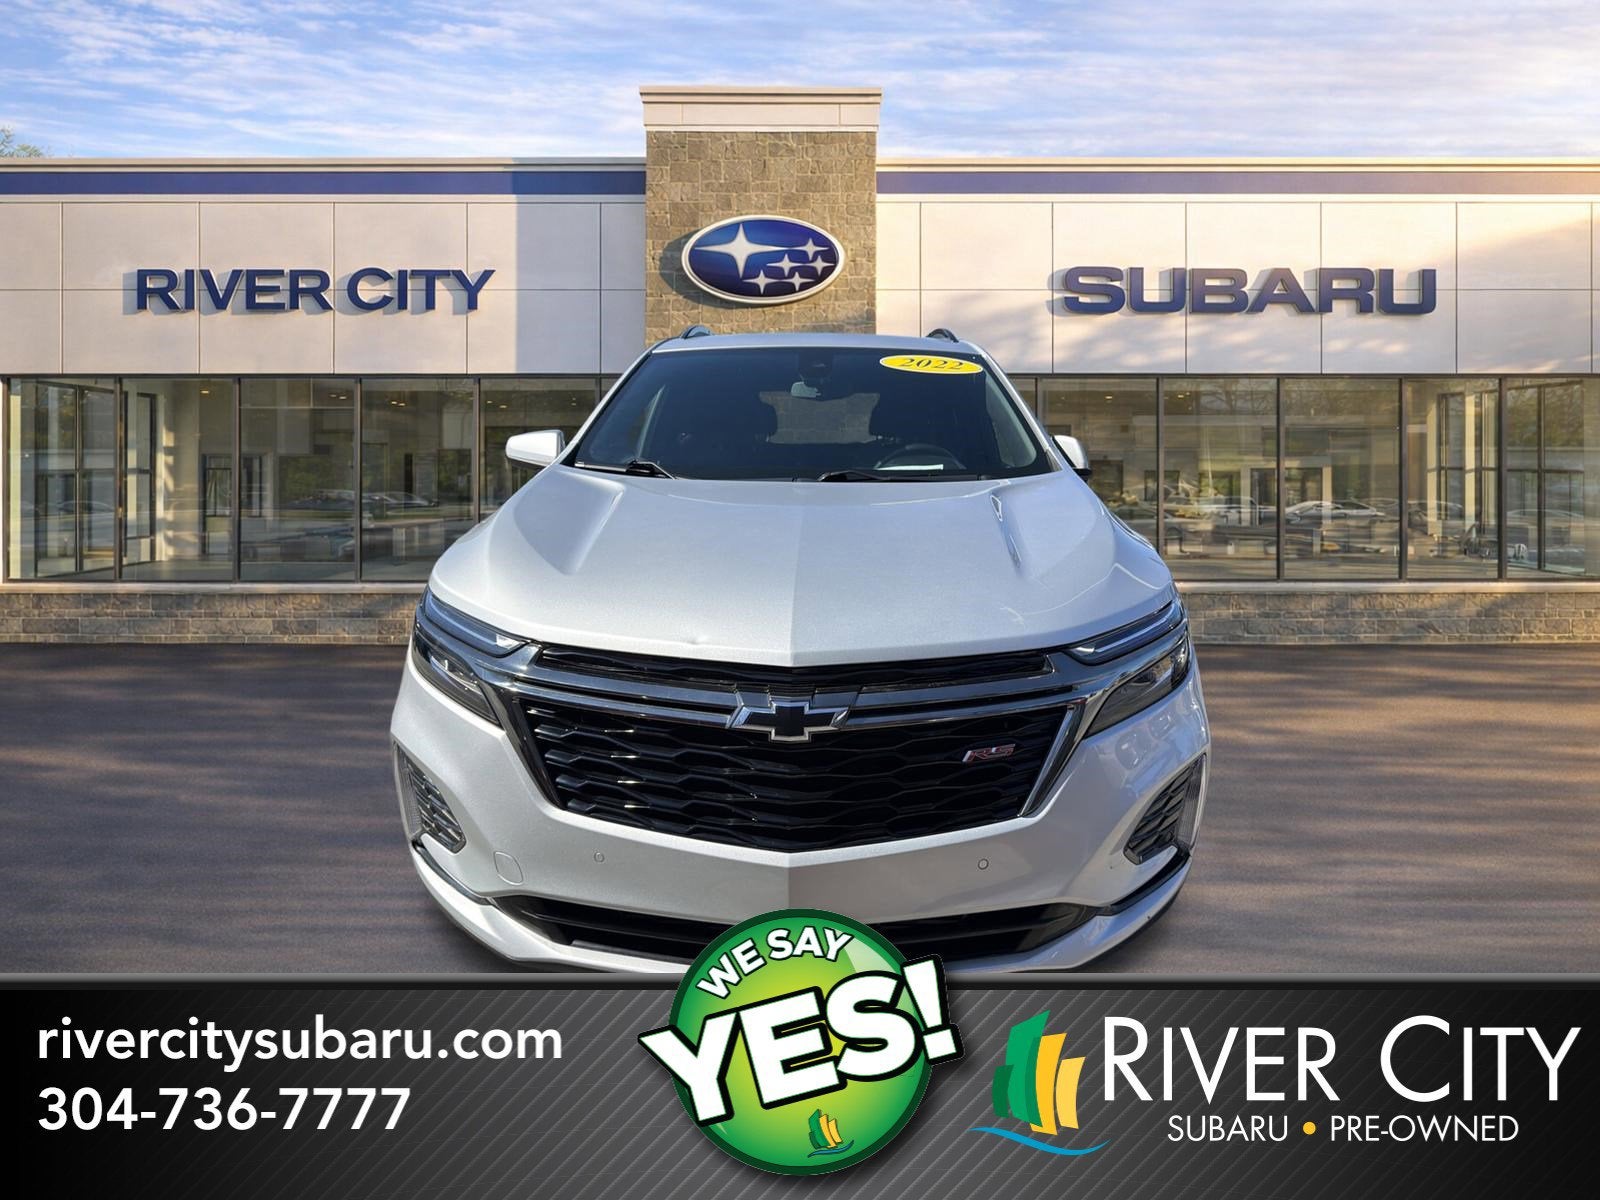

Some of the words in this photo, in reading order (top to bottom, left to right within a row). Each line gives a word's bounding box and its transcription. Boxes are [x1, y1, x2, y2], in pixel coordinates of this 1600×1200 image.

[137, 268, 333, 312] RIVER
[346, 267, 496, 312] CITY
[1061, 266, 1437, 315] SUBARU
[898, 358, 963, 370] 2022
[962, 743, 1016, 762] RS
